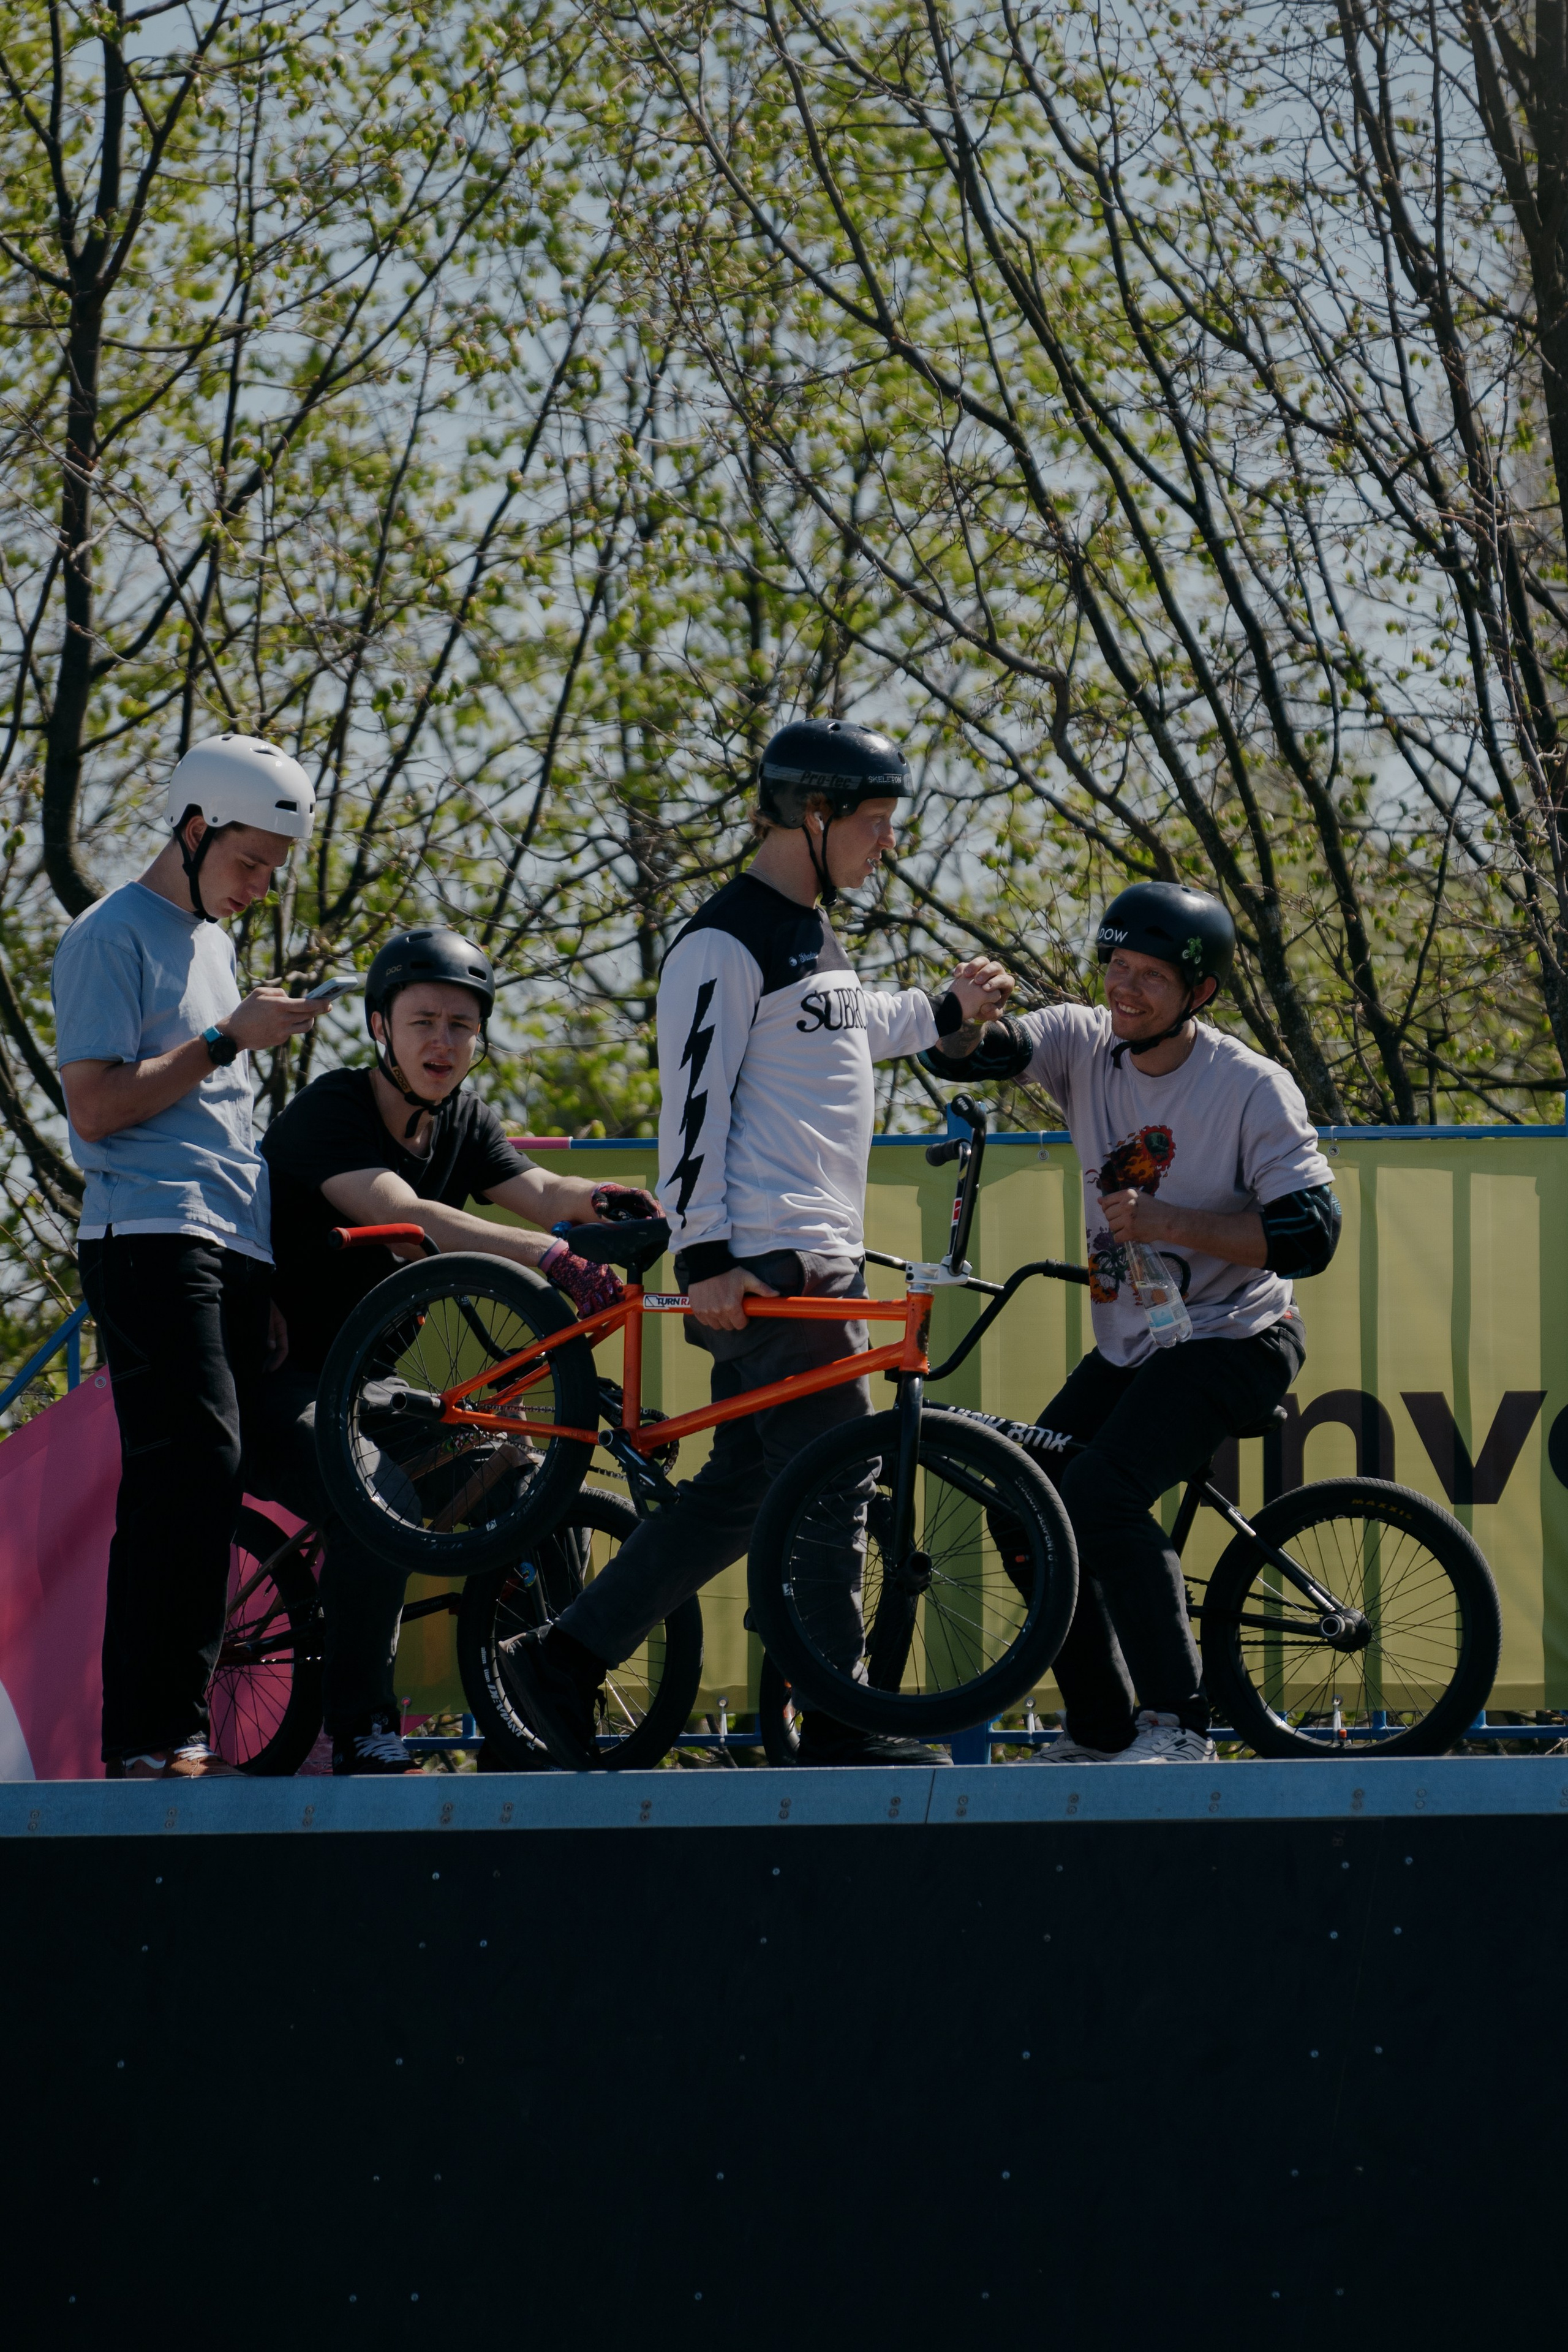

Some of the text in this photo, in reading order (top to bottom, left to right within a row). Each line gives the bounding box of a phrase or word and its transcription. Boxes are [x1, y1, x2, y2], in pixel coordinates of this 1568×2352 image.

[1097, 928, 1128, 943] DOW
[796, 987, 867, 1033] SUBR
[1351, 1498, 1414, 1520] MAXXIS
